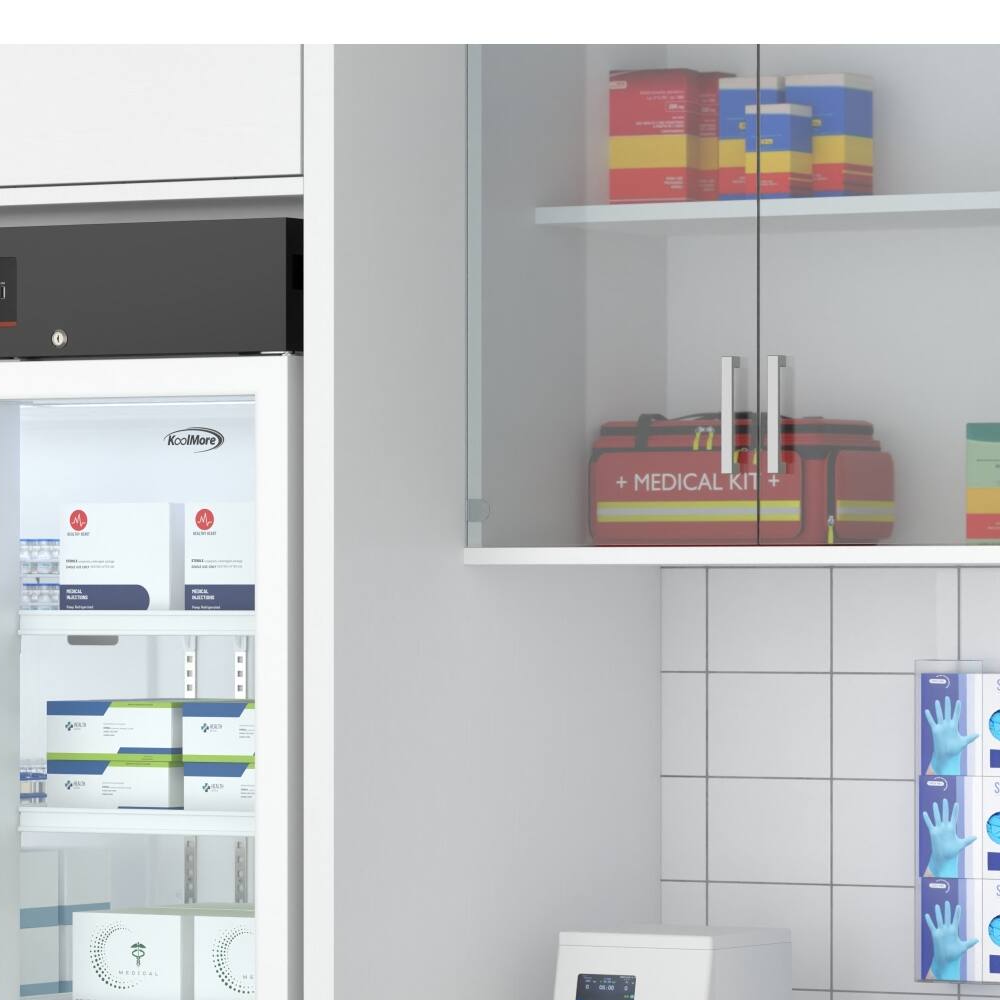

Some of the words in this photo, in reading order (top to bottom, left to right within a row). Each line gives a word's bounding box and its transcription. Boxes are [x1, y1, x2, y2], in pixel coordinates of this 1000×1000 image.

[167, 434, 216, 446] KoolMore
[634, 473, 723, 492] MEDICAL
[729, 472, 758, 490] KIT
[118, 969, 159, 977] MEDICAL
